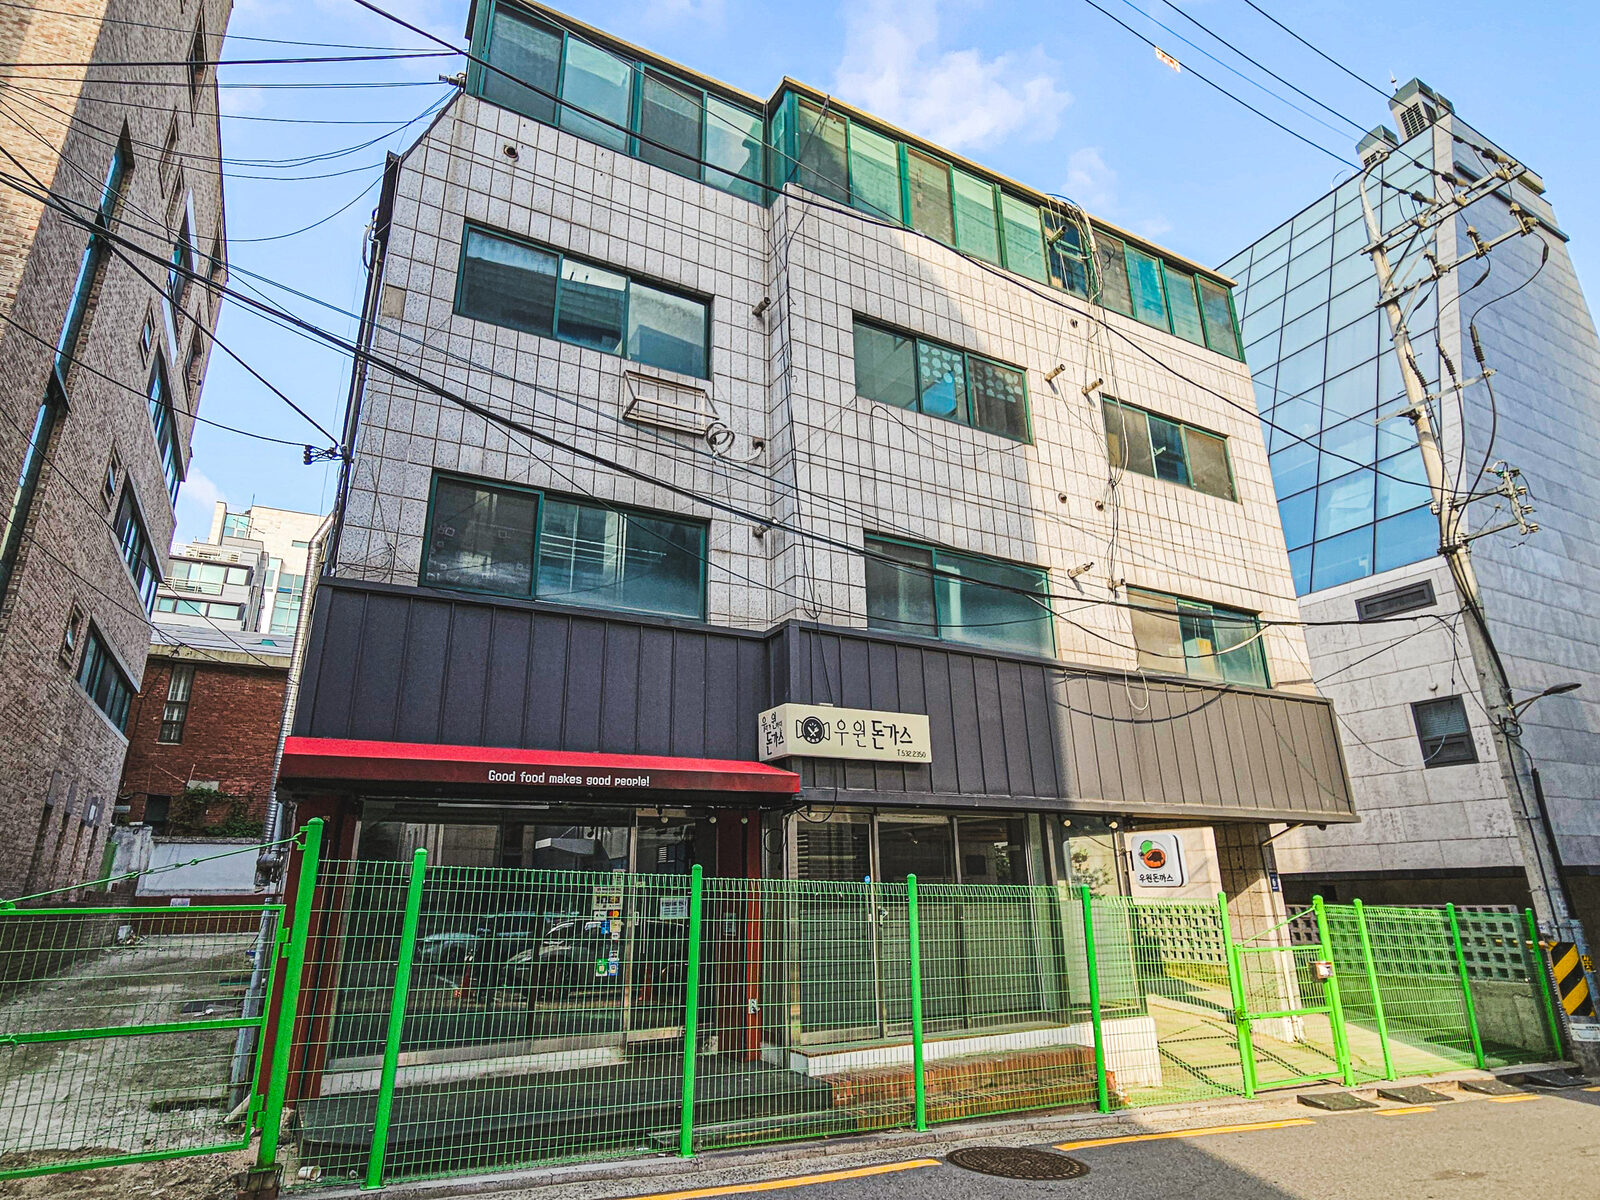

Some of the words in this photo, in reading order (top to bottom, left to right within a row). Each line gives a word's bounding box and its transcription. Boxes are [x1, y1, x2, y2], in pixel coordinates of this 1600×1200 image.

[488, 769, 516, 782] Good
[520, 771, 545, 783] food
[549, 773, 582, 785] makes
[586, 775, 612, 786] good
[614, 776, 650, 787] people!
[1139, 873, 1174, 883] 우원돈까스
